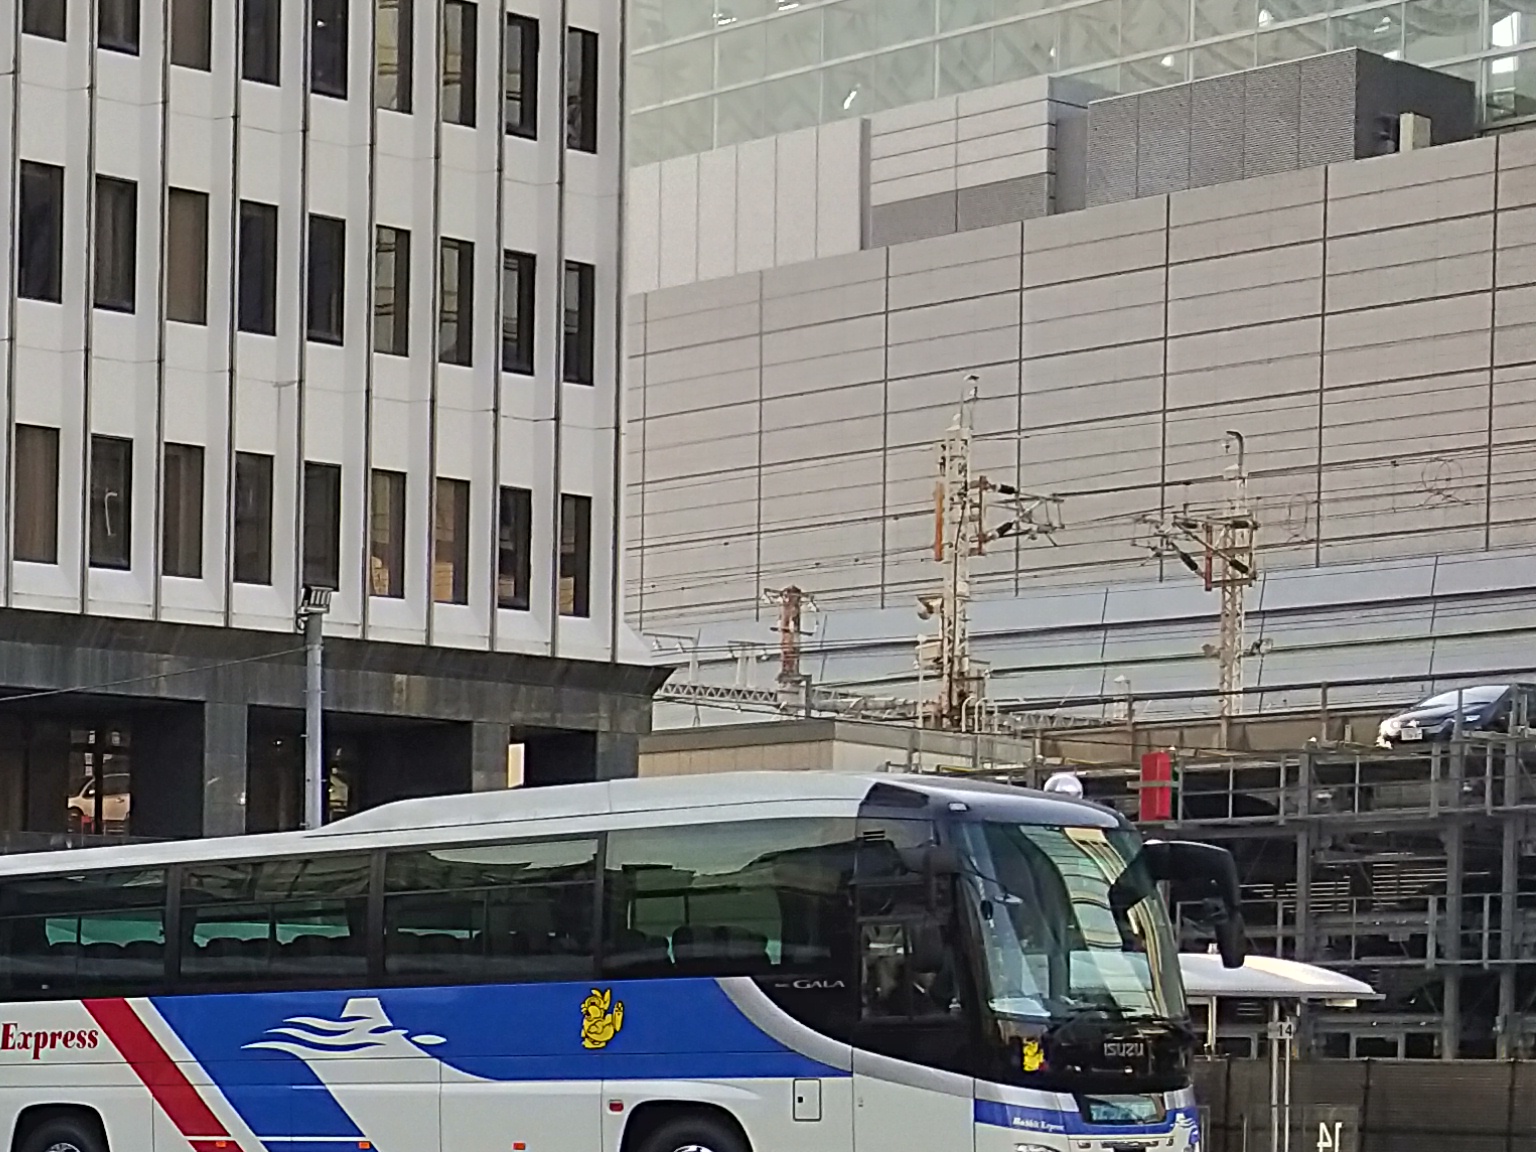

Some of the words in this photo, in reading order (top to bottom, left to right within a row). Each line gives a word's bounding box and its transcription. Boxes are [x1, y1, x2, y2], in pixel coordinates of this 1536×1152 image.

[793, 980, 846, 989] GALA
[1278, 1023, 1293, 1037] 14
[0, 1022, 99, 1060] Express
[1103, 1042, 1145, 1057] ISUZU
